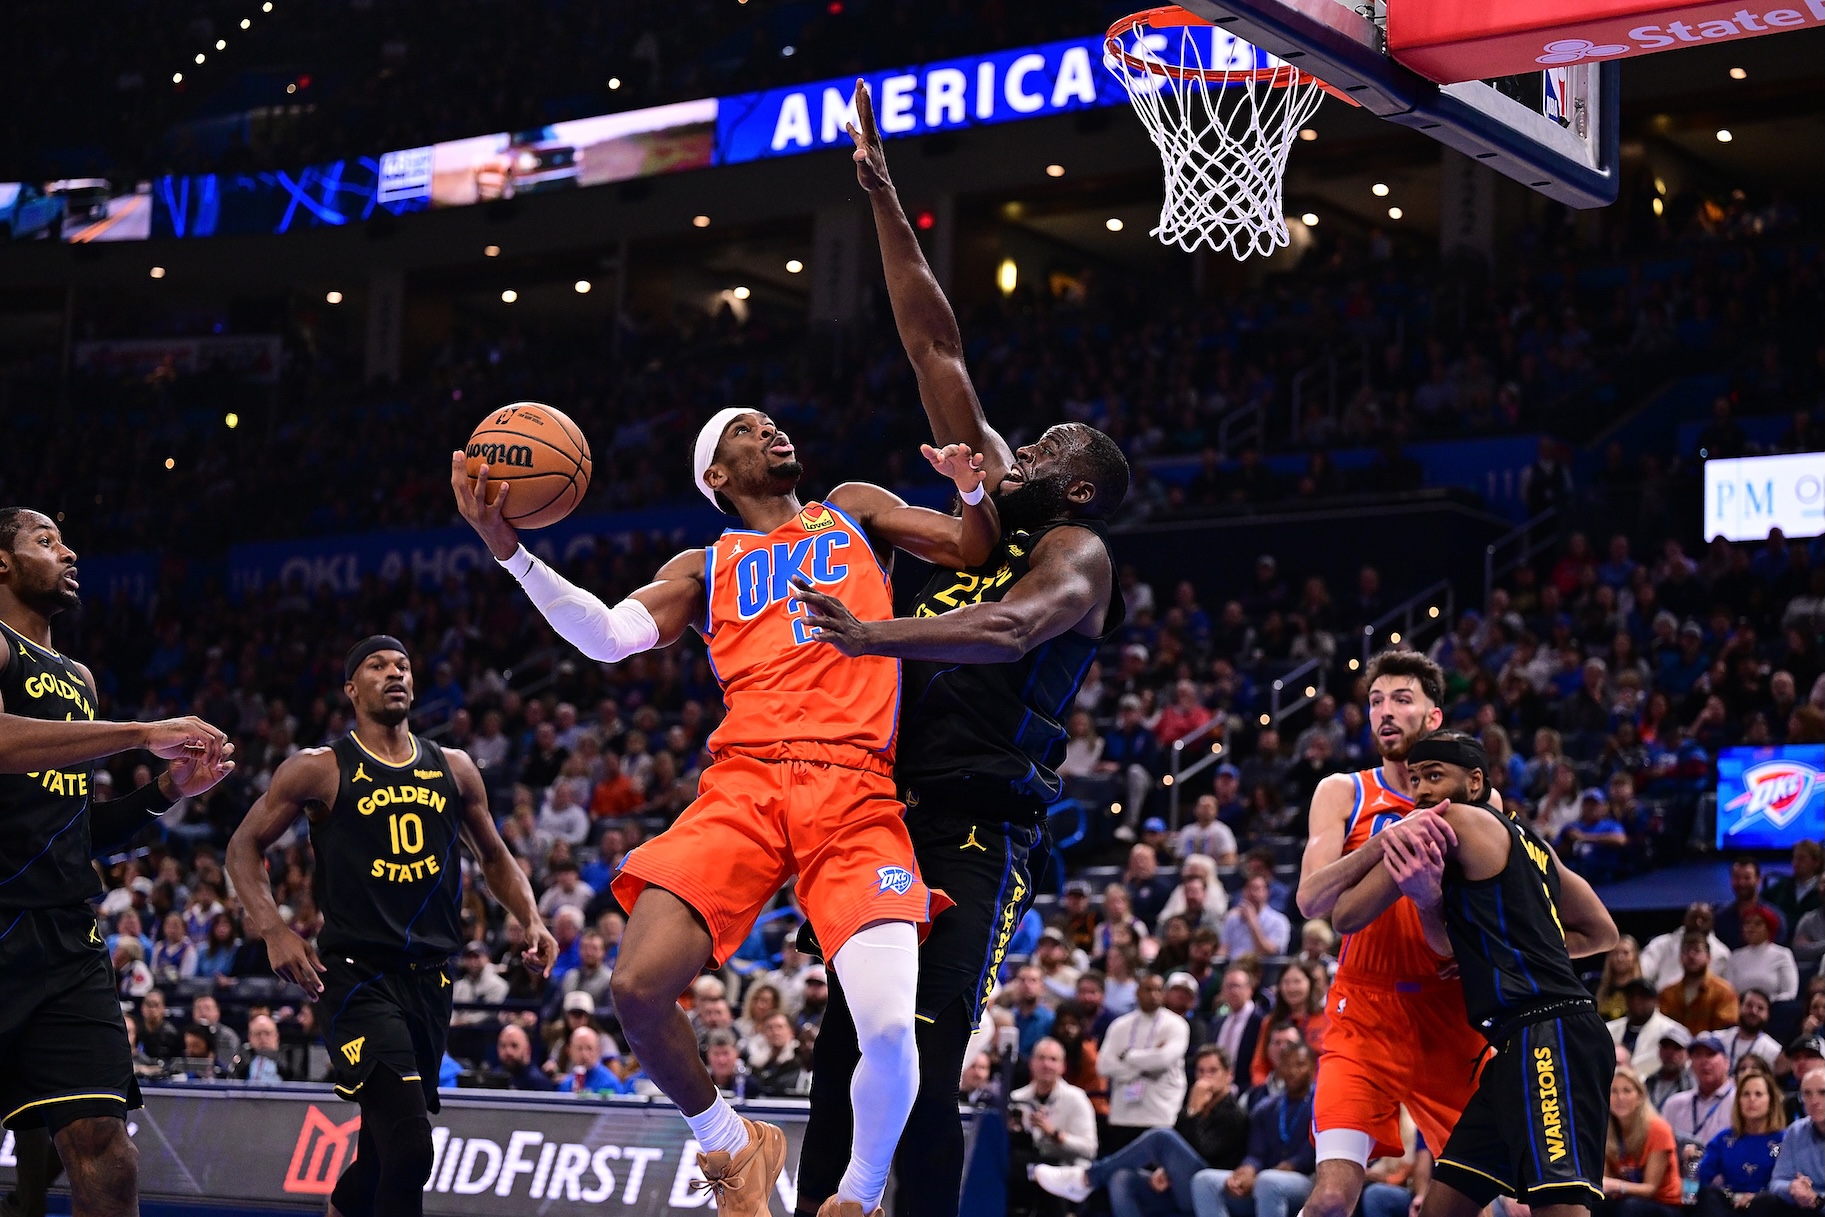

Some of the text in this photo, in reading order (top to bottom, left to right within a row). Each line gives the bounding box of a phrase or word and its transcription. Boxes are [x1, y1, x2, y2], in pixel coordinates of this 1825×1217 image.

[1628, 9, 1806, 49] State
[466, 443, 533, 468] Wilson
[736, 530, 850, 621] OKC
[25, 672, 94, 721] GOLDEN
[27, 769, 88, 796] TATE
[357, 785, 446, 816] GOLDEN
[389, 812, 424, 855] 10
[371, 855, 440, 882] STATE
[880, 872, 907, 890] OKC
[1534, 1046, 1567, 1162] WARRIORS
